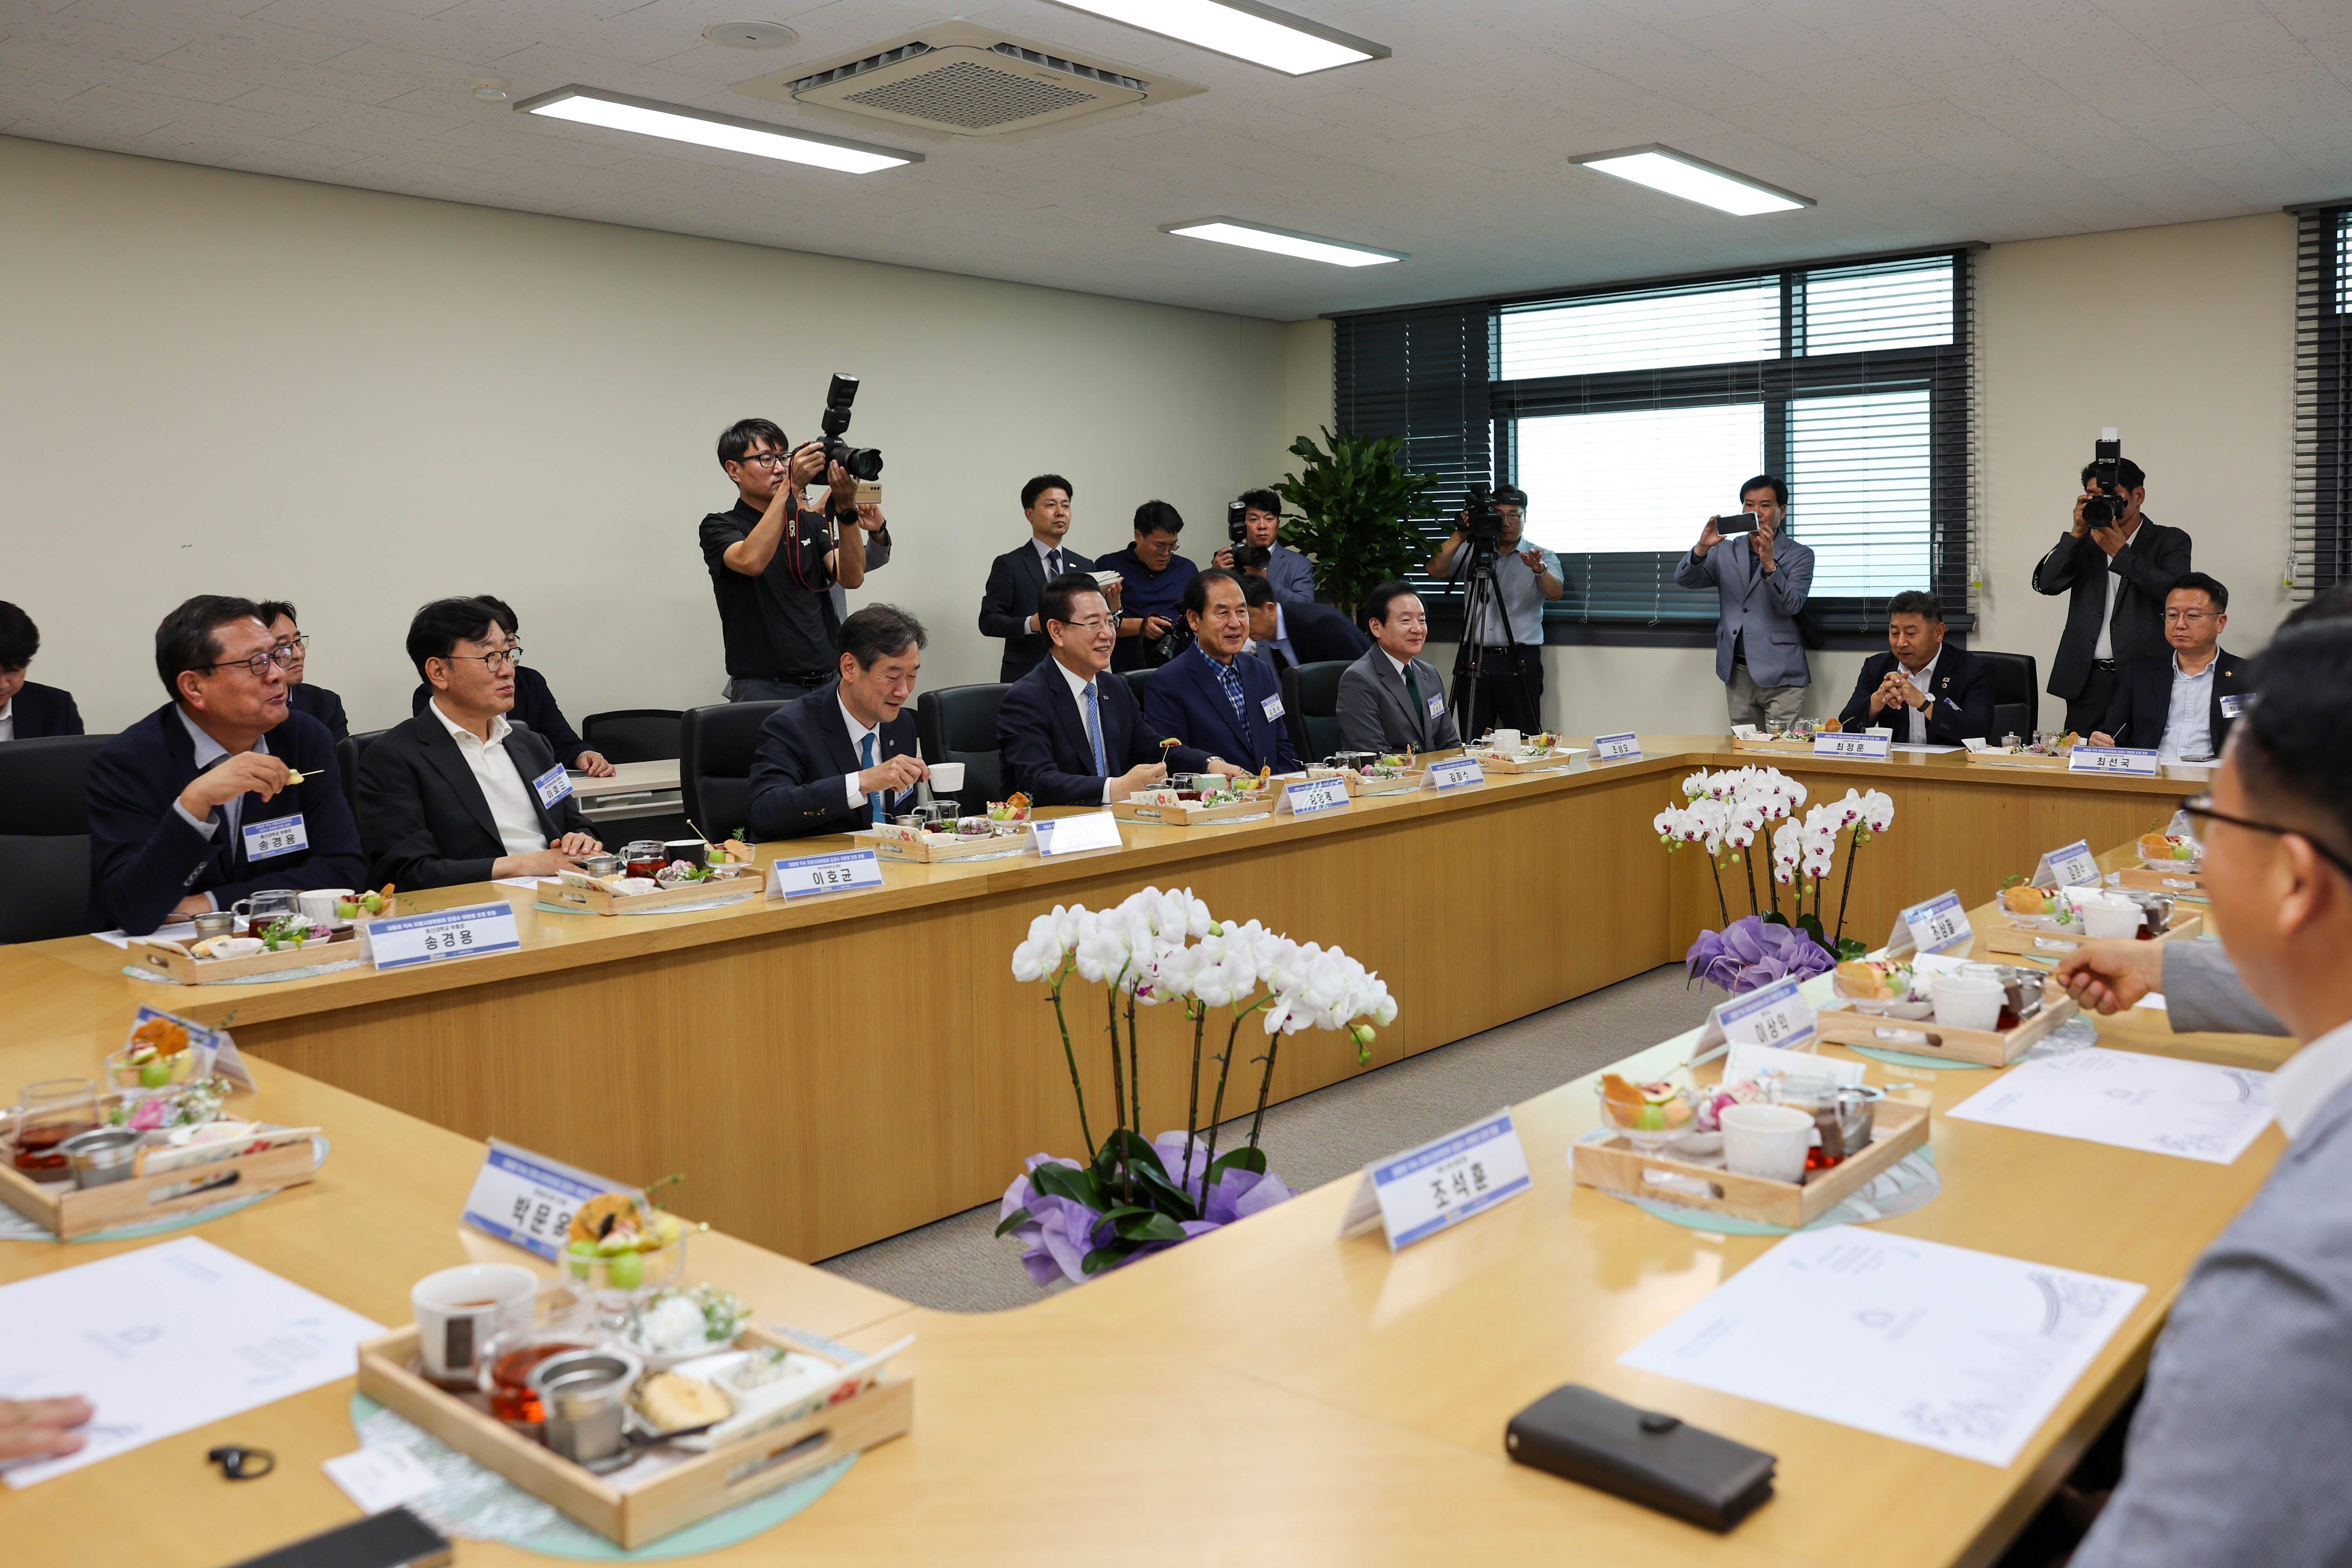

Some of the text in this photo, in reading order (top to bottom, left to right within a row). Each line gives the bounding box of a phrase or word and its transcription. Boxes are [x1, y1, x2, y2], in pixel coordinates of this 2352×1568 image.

[1611, 744, 1629, 754] 조성오
[1836, 742, 1864, 752] 최정훈
[2096, 757, 2130, 768] 최선국
[1449, 770, 1469, 782] 김희수
[258, 833, 296, 851] 송경용
[811, 867, 853, 886] 이호균
[423, 929, 474, 950] 송경용
